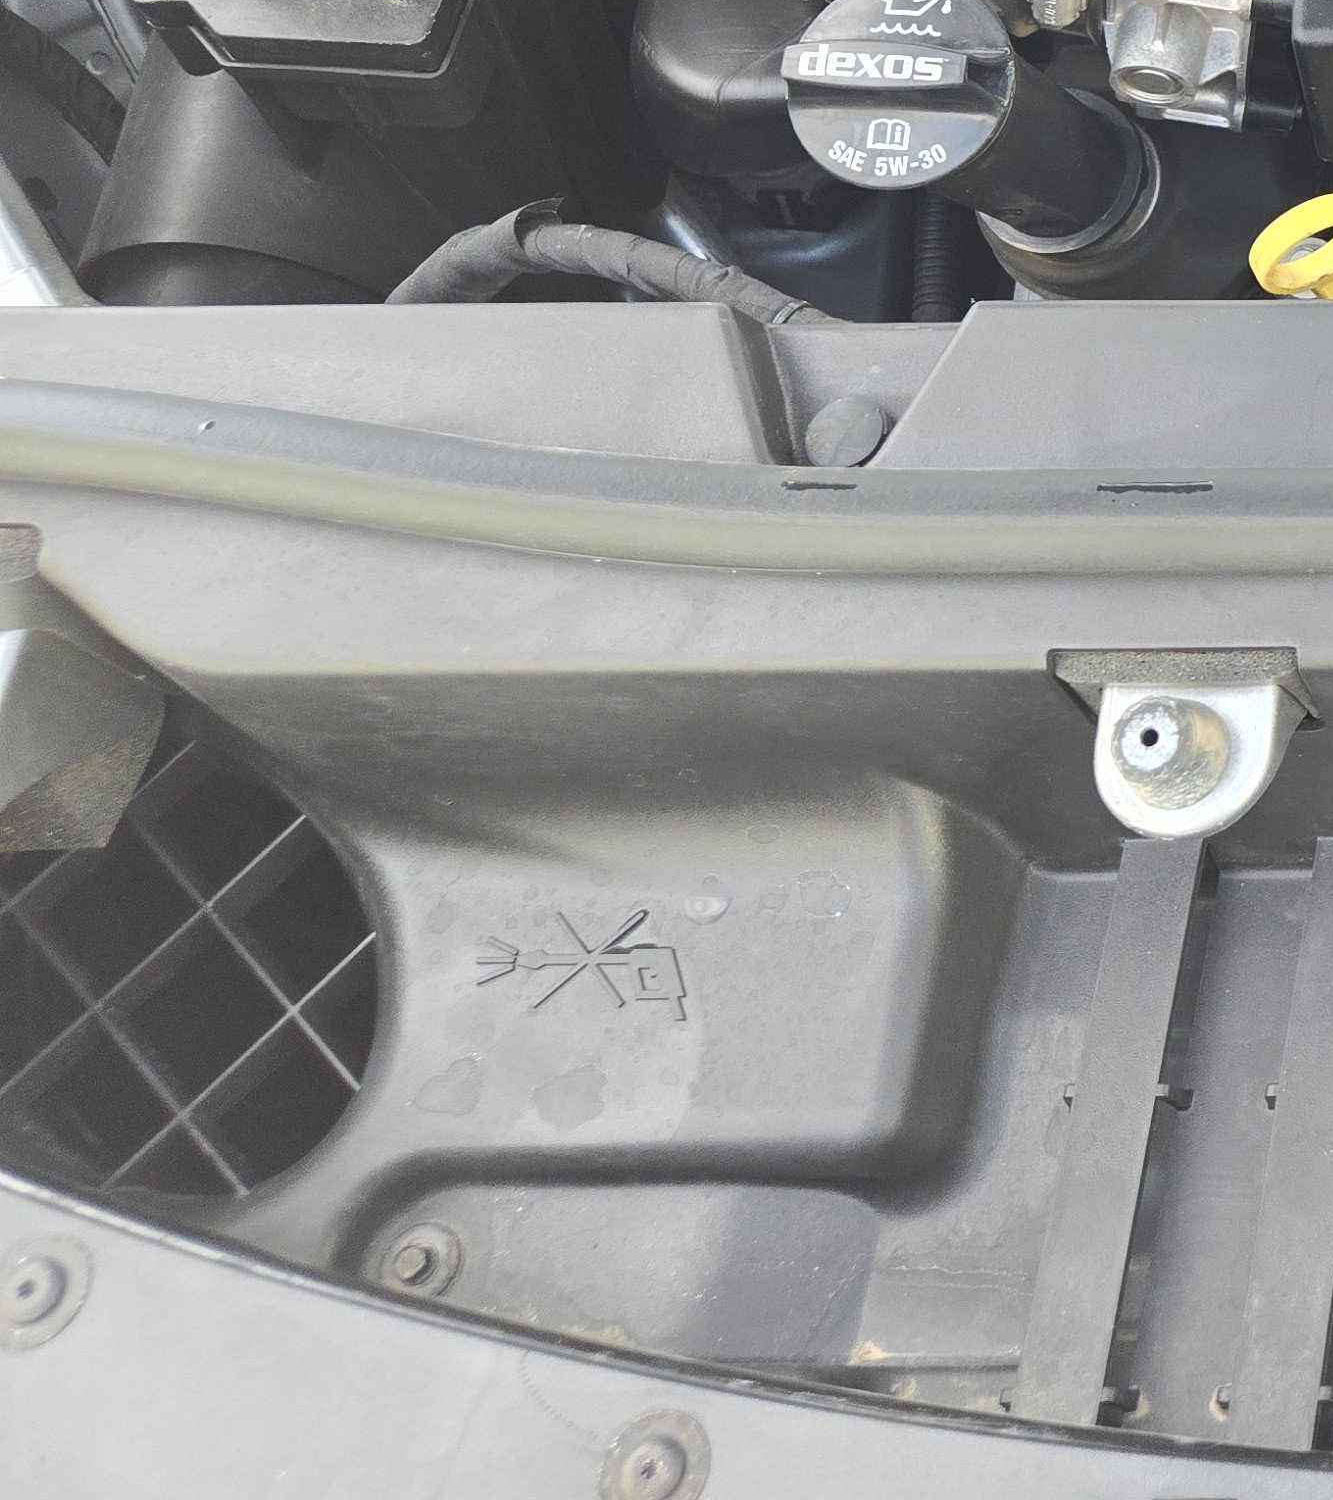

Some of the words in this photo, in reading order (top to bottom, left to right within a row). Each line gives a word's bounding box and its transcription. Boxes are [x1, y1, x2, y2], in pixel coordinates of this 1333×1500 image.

[797, 44, 944, 82] dexos
[828, 140, 868, 172] SAE
[874, 143, 947, 176] 5W-30
